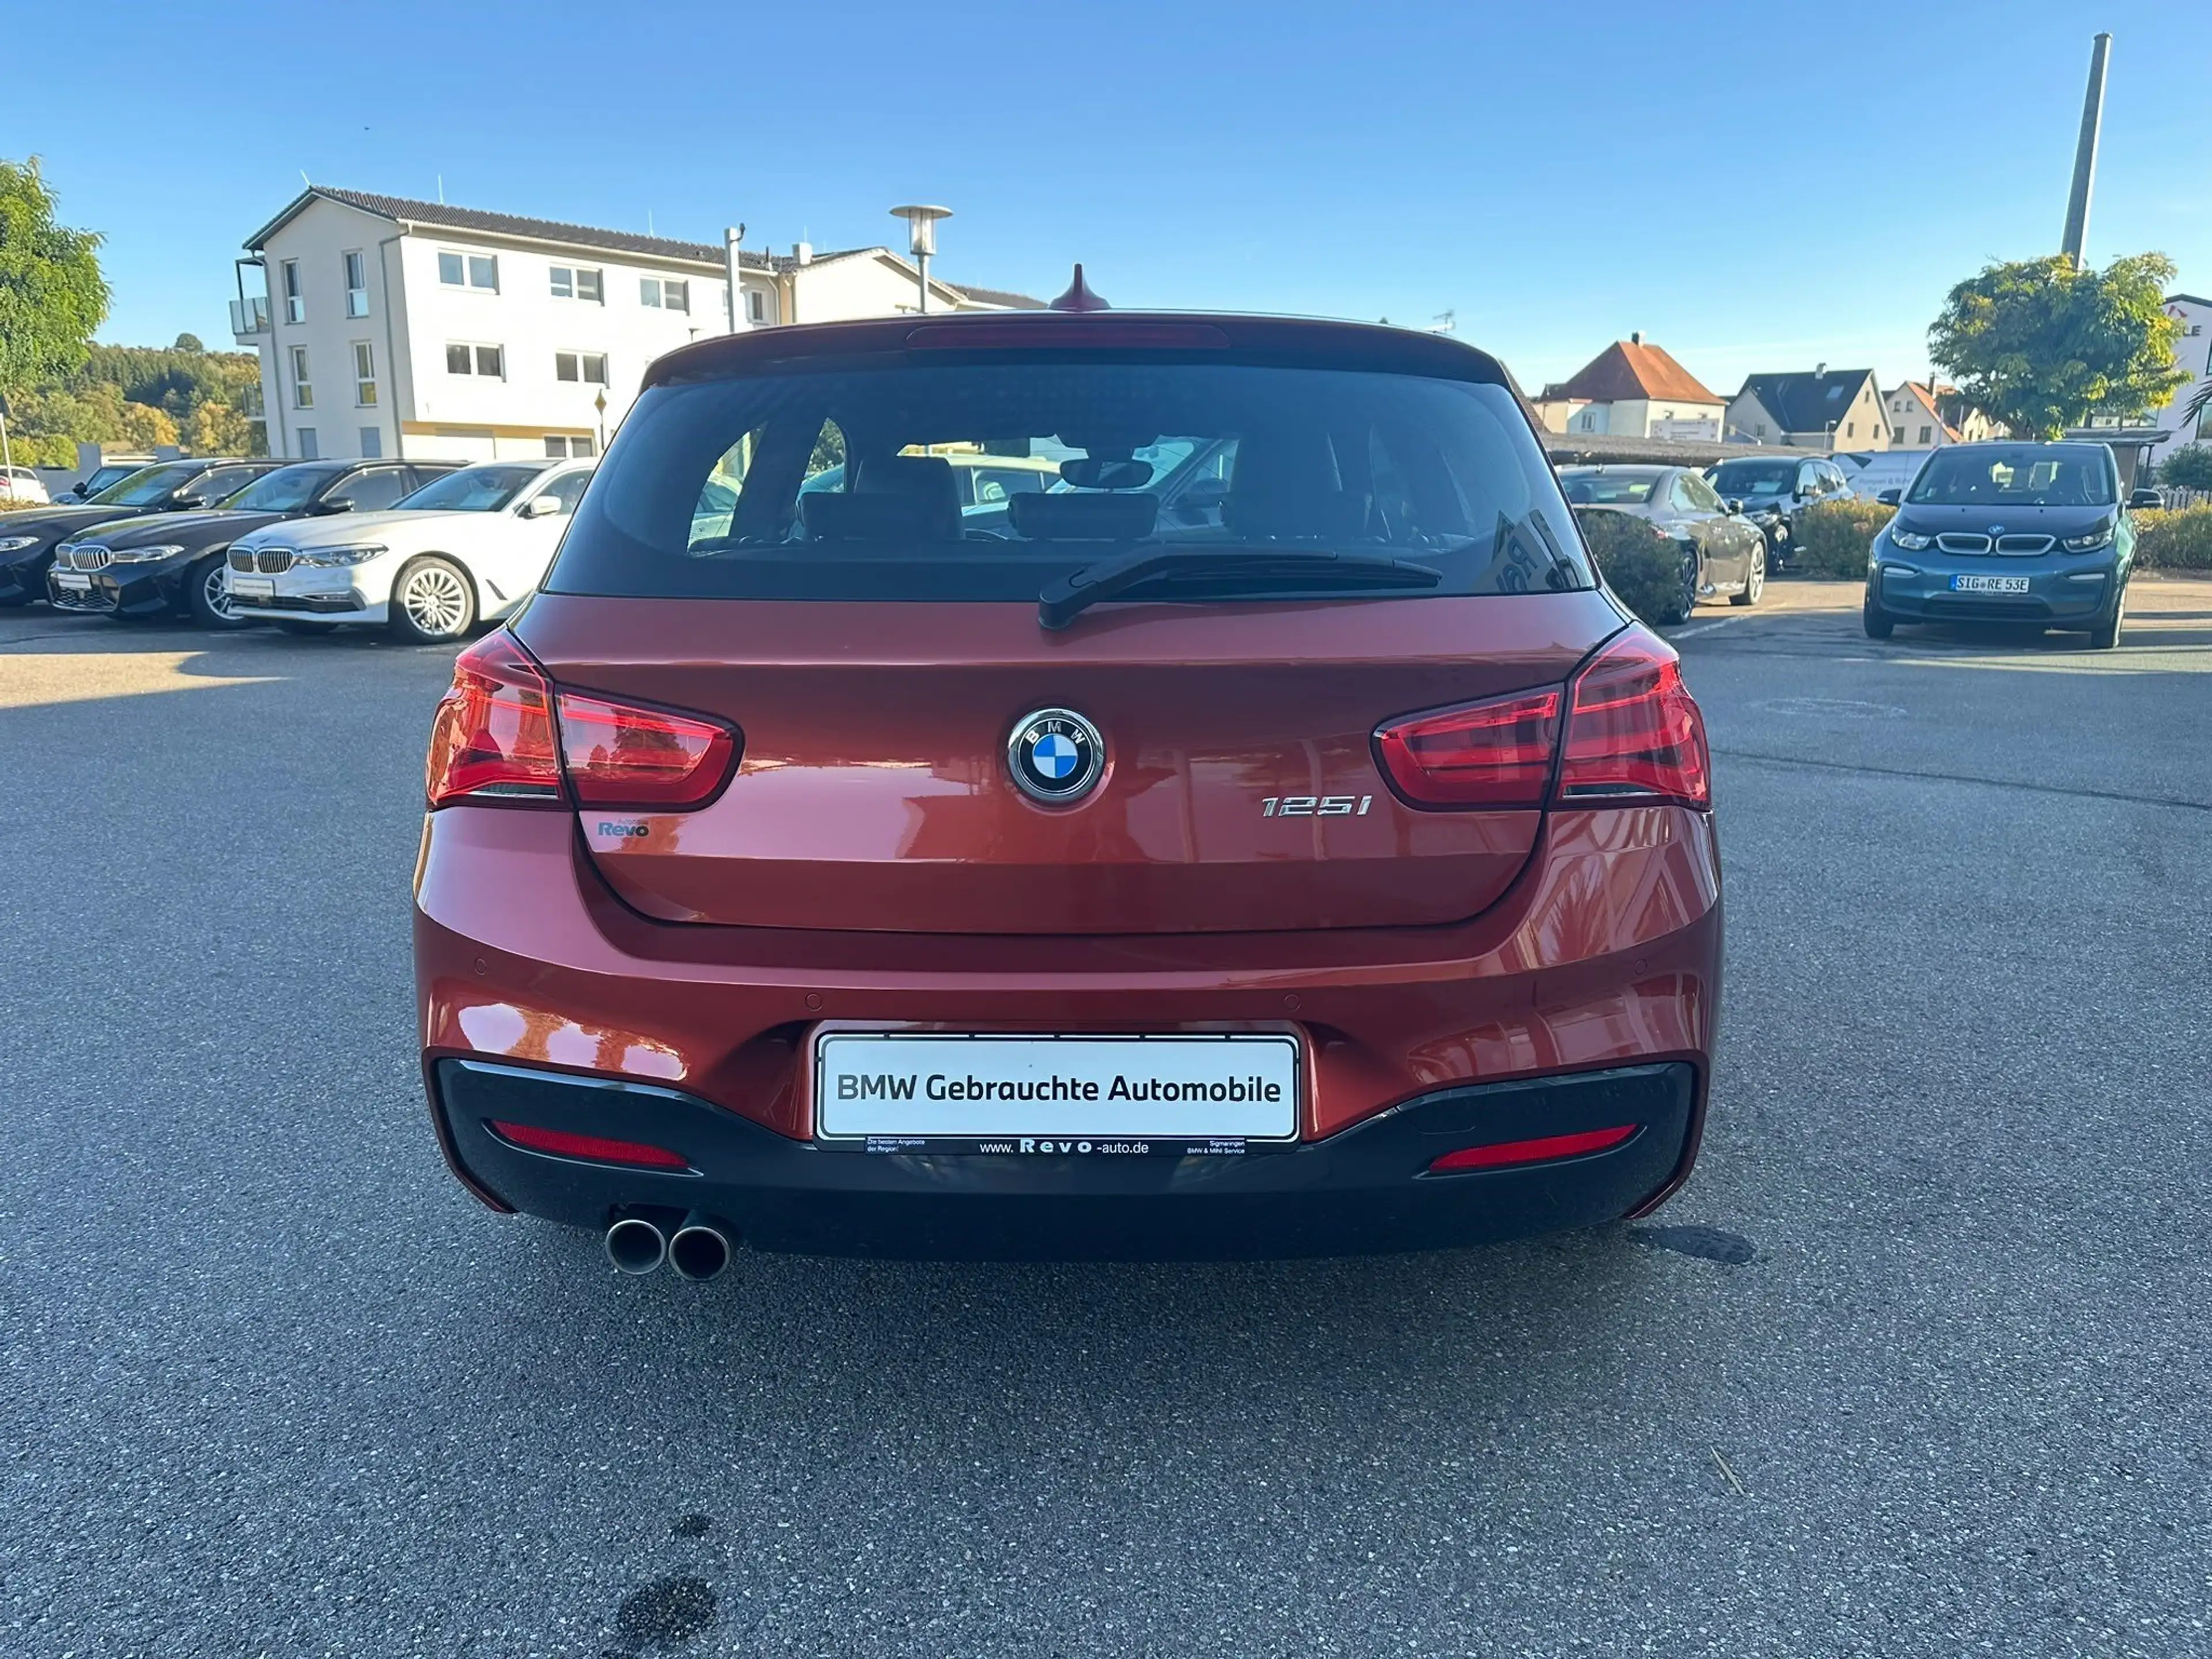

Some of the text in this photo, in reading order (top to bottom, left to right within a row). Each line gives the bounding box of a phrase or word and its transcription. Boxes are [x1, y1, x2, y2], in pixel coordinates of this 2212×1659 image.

[1957, 577, 2027, 590] SIG RE 53E
[1026, 721, 1086, 744] BMW
[598, 822, 649, 836] Revo
[838, 1074, 1281, 1103] BMW Gebrauchte Automobile
